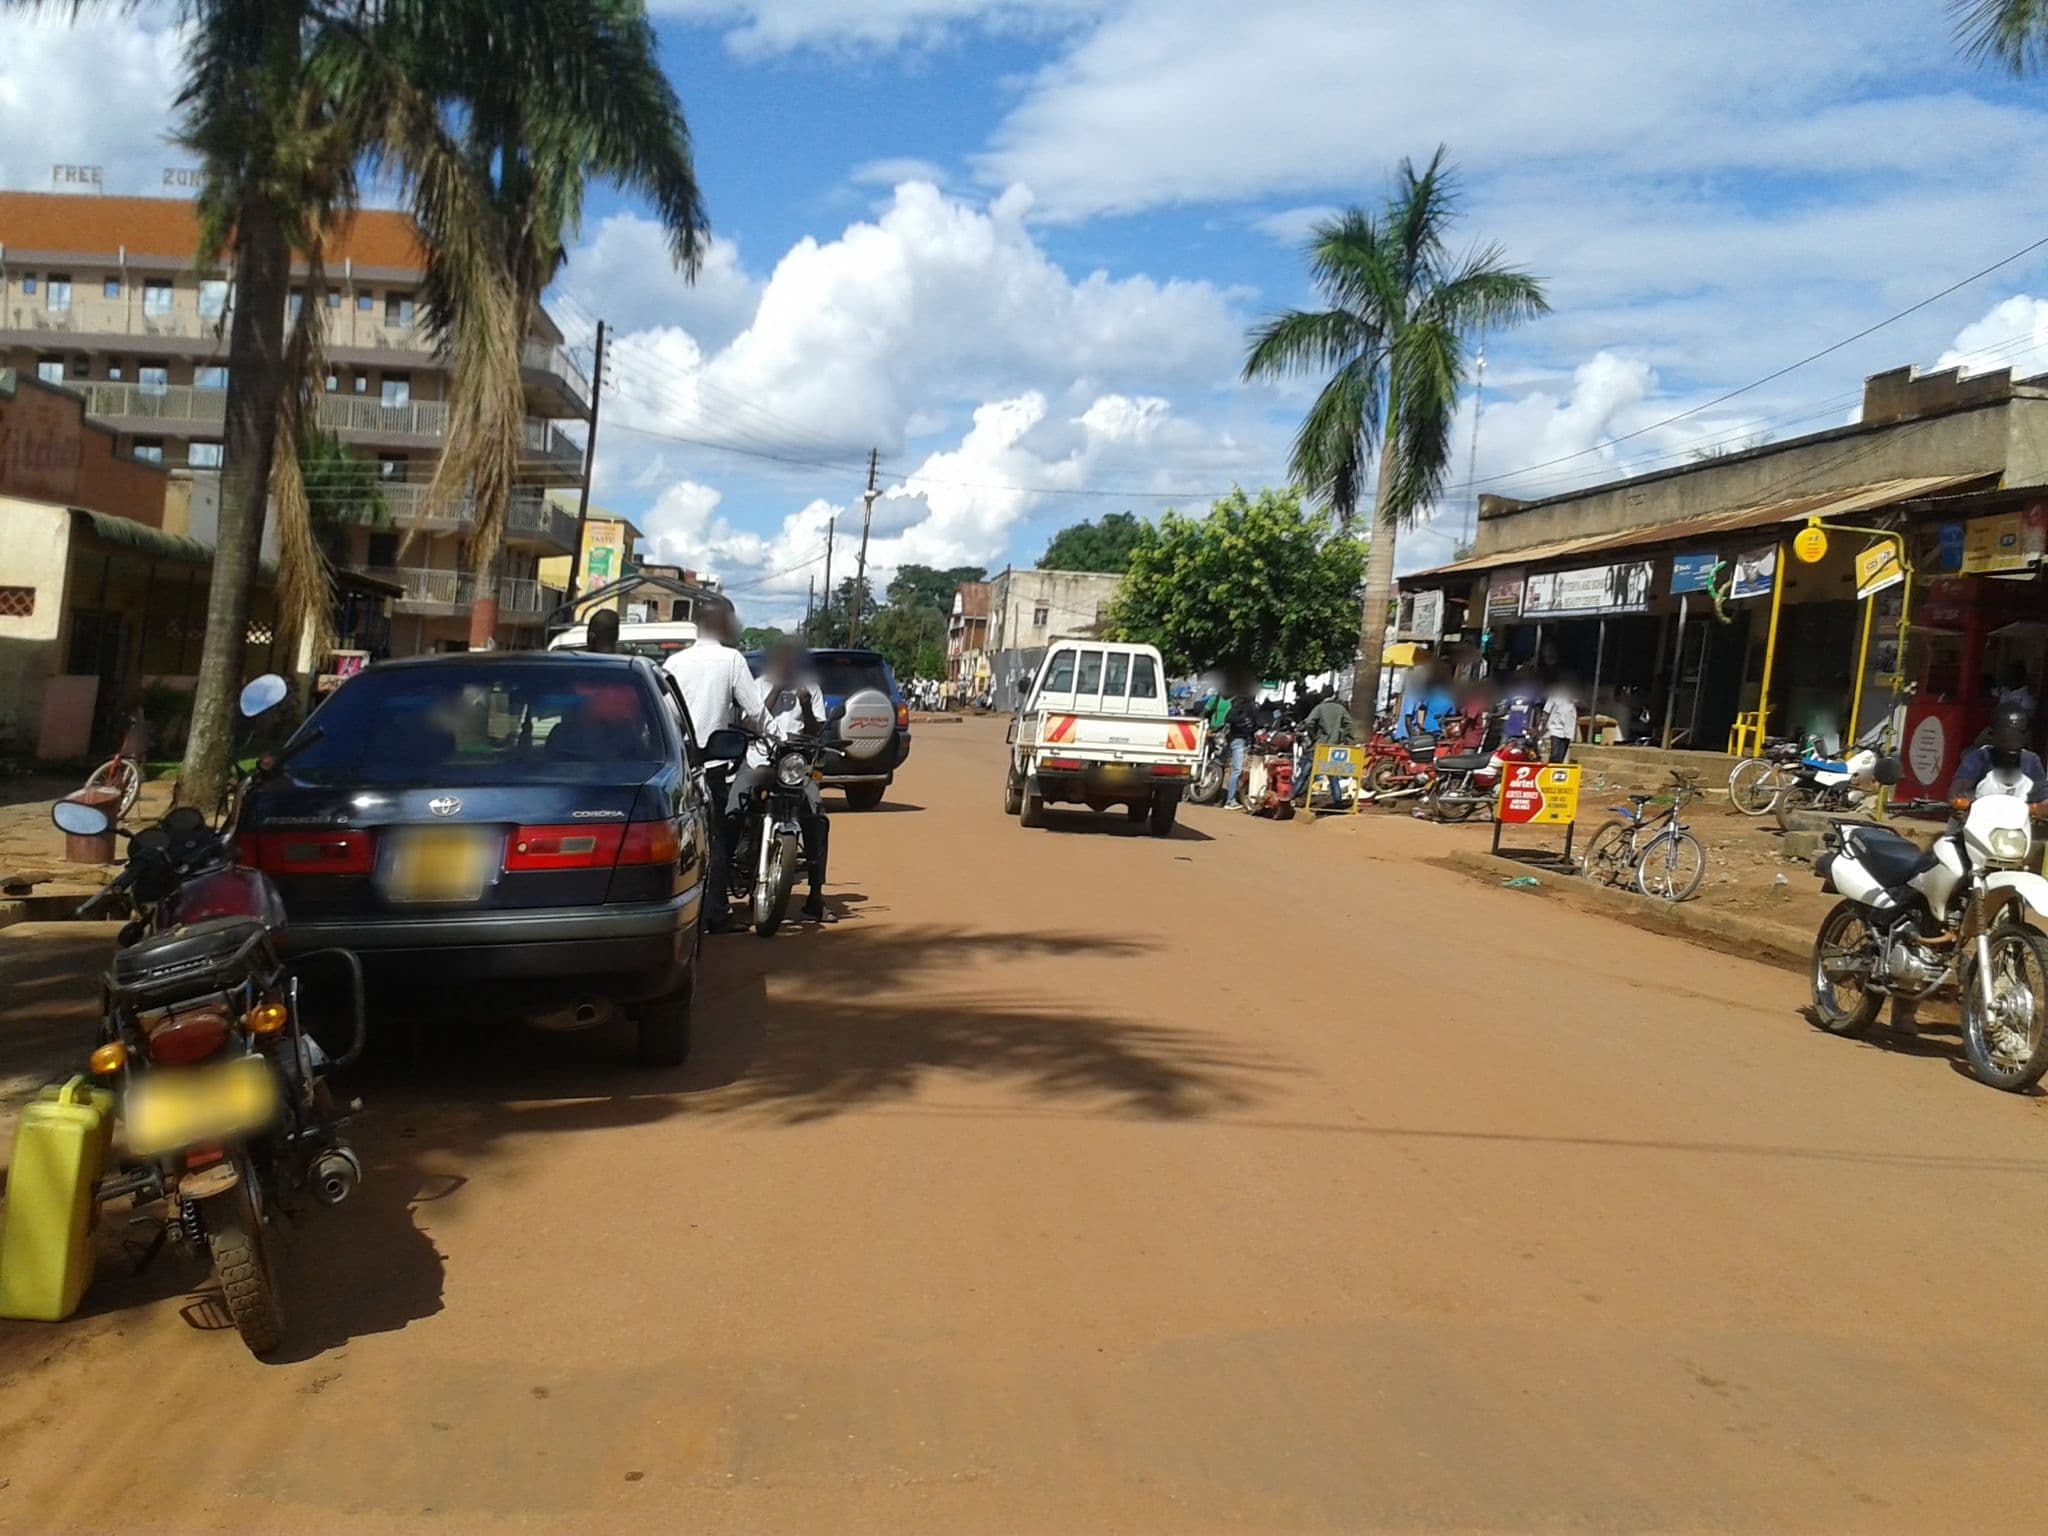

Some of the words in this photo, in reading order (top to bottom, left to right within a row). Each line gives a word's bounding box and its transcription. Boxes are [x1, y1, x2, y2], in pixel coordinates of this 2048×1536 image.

[53, 164, 103, 185] FREE
[1509, 780, 1534, 788] airtel
[571, 810, 626, 818] CORONA
